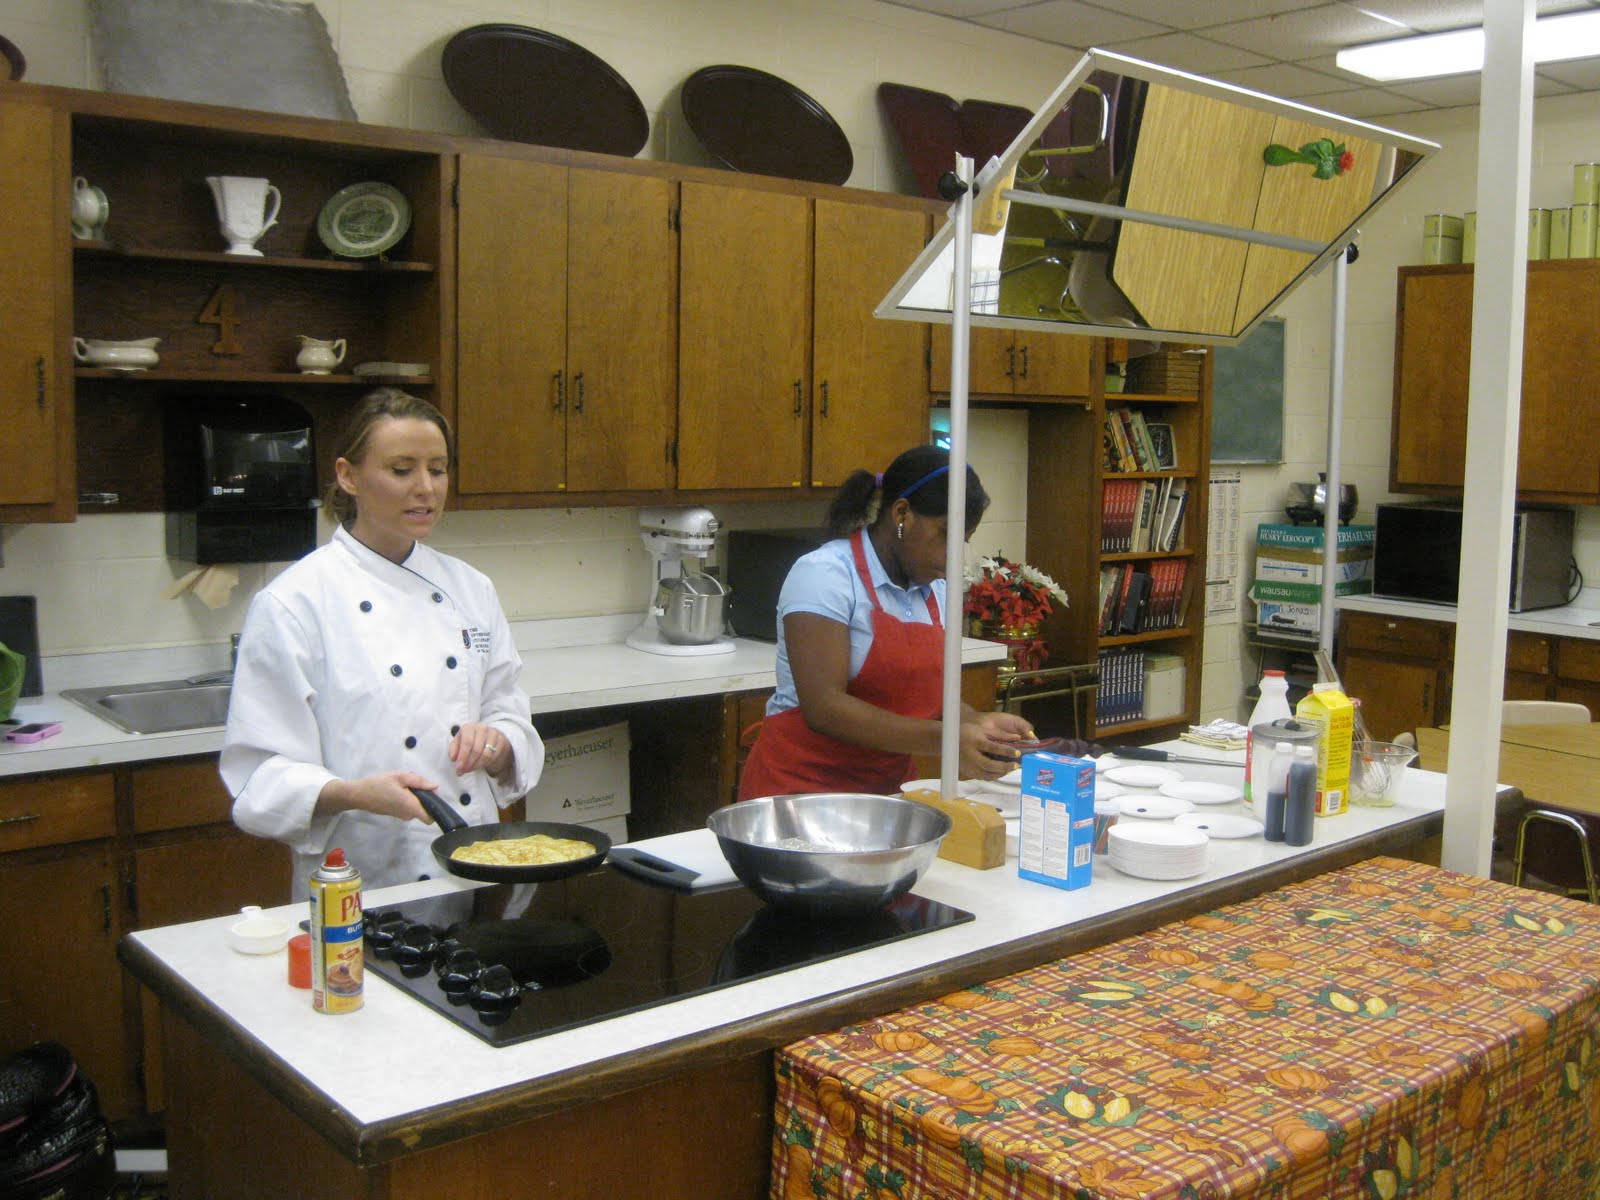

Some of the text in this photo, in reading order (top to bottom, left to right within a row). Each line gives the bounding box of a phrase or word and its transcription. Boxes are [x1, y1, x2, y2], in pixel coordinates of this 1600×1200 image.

[200, 287, 241, 354] 4
[1260, 532, 1315, 544] HUSKY XEROCOPY
[544, 738, 614, 765] eyerhaeuser
[342, 892, 362, 922] PA
